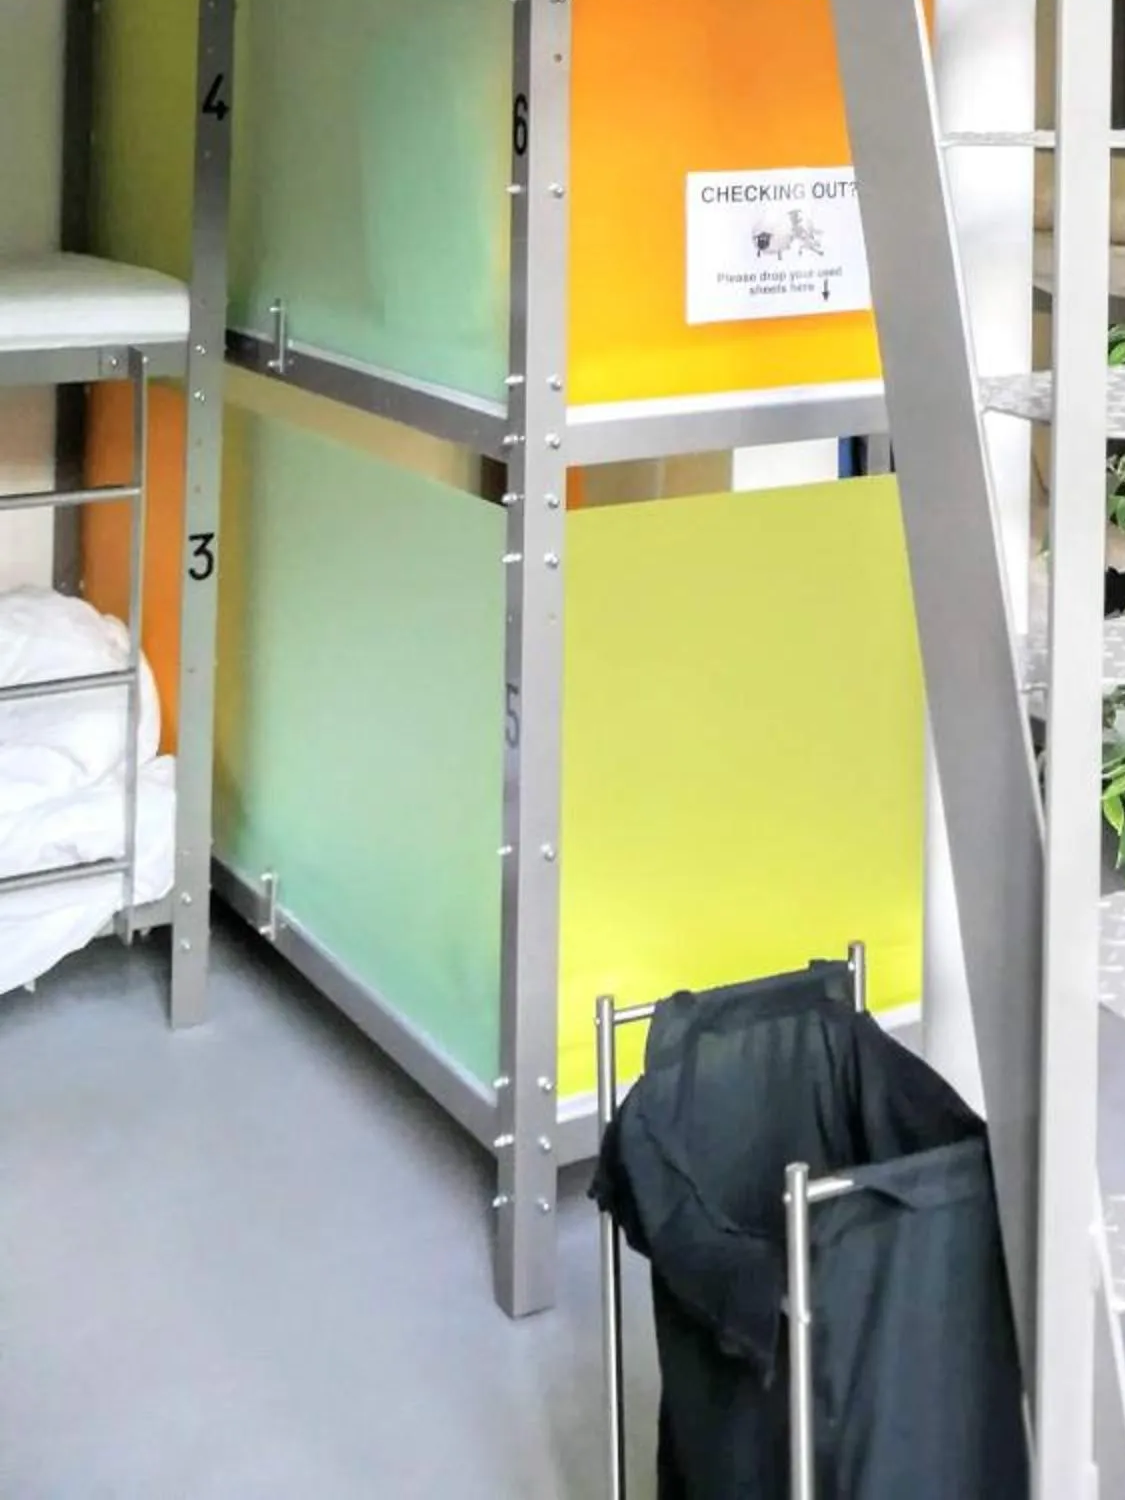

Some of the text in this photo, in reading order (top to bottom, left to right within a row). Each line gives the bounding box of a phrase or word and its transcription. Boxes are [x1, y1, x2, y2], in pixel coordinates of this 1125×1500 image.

[201, 72, 231, 122] 4
[513, 92, 529, 157] 6
[701, 183, 806, 204] CHECKING
[187, 531, 216, 583] 3
[505, 682, 520, 749] 5
